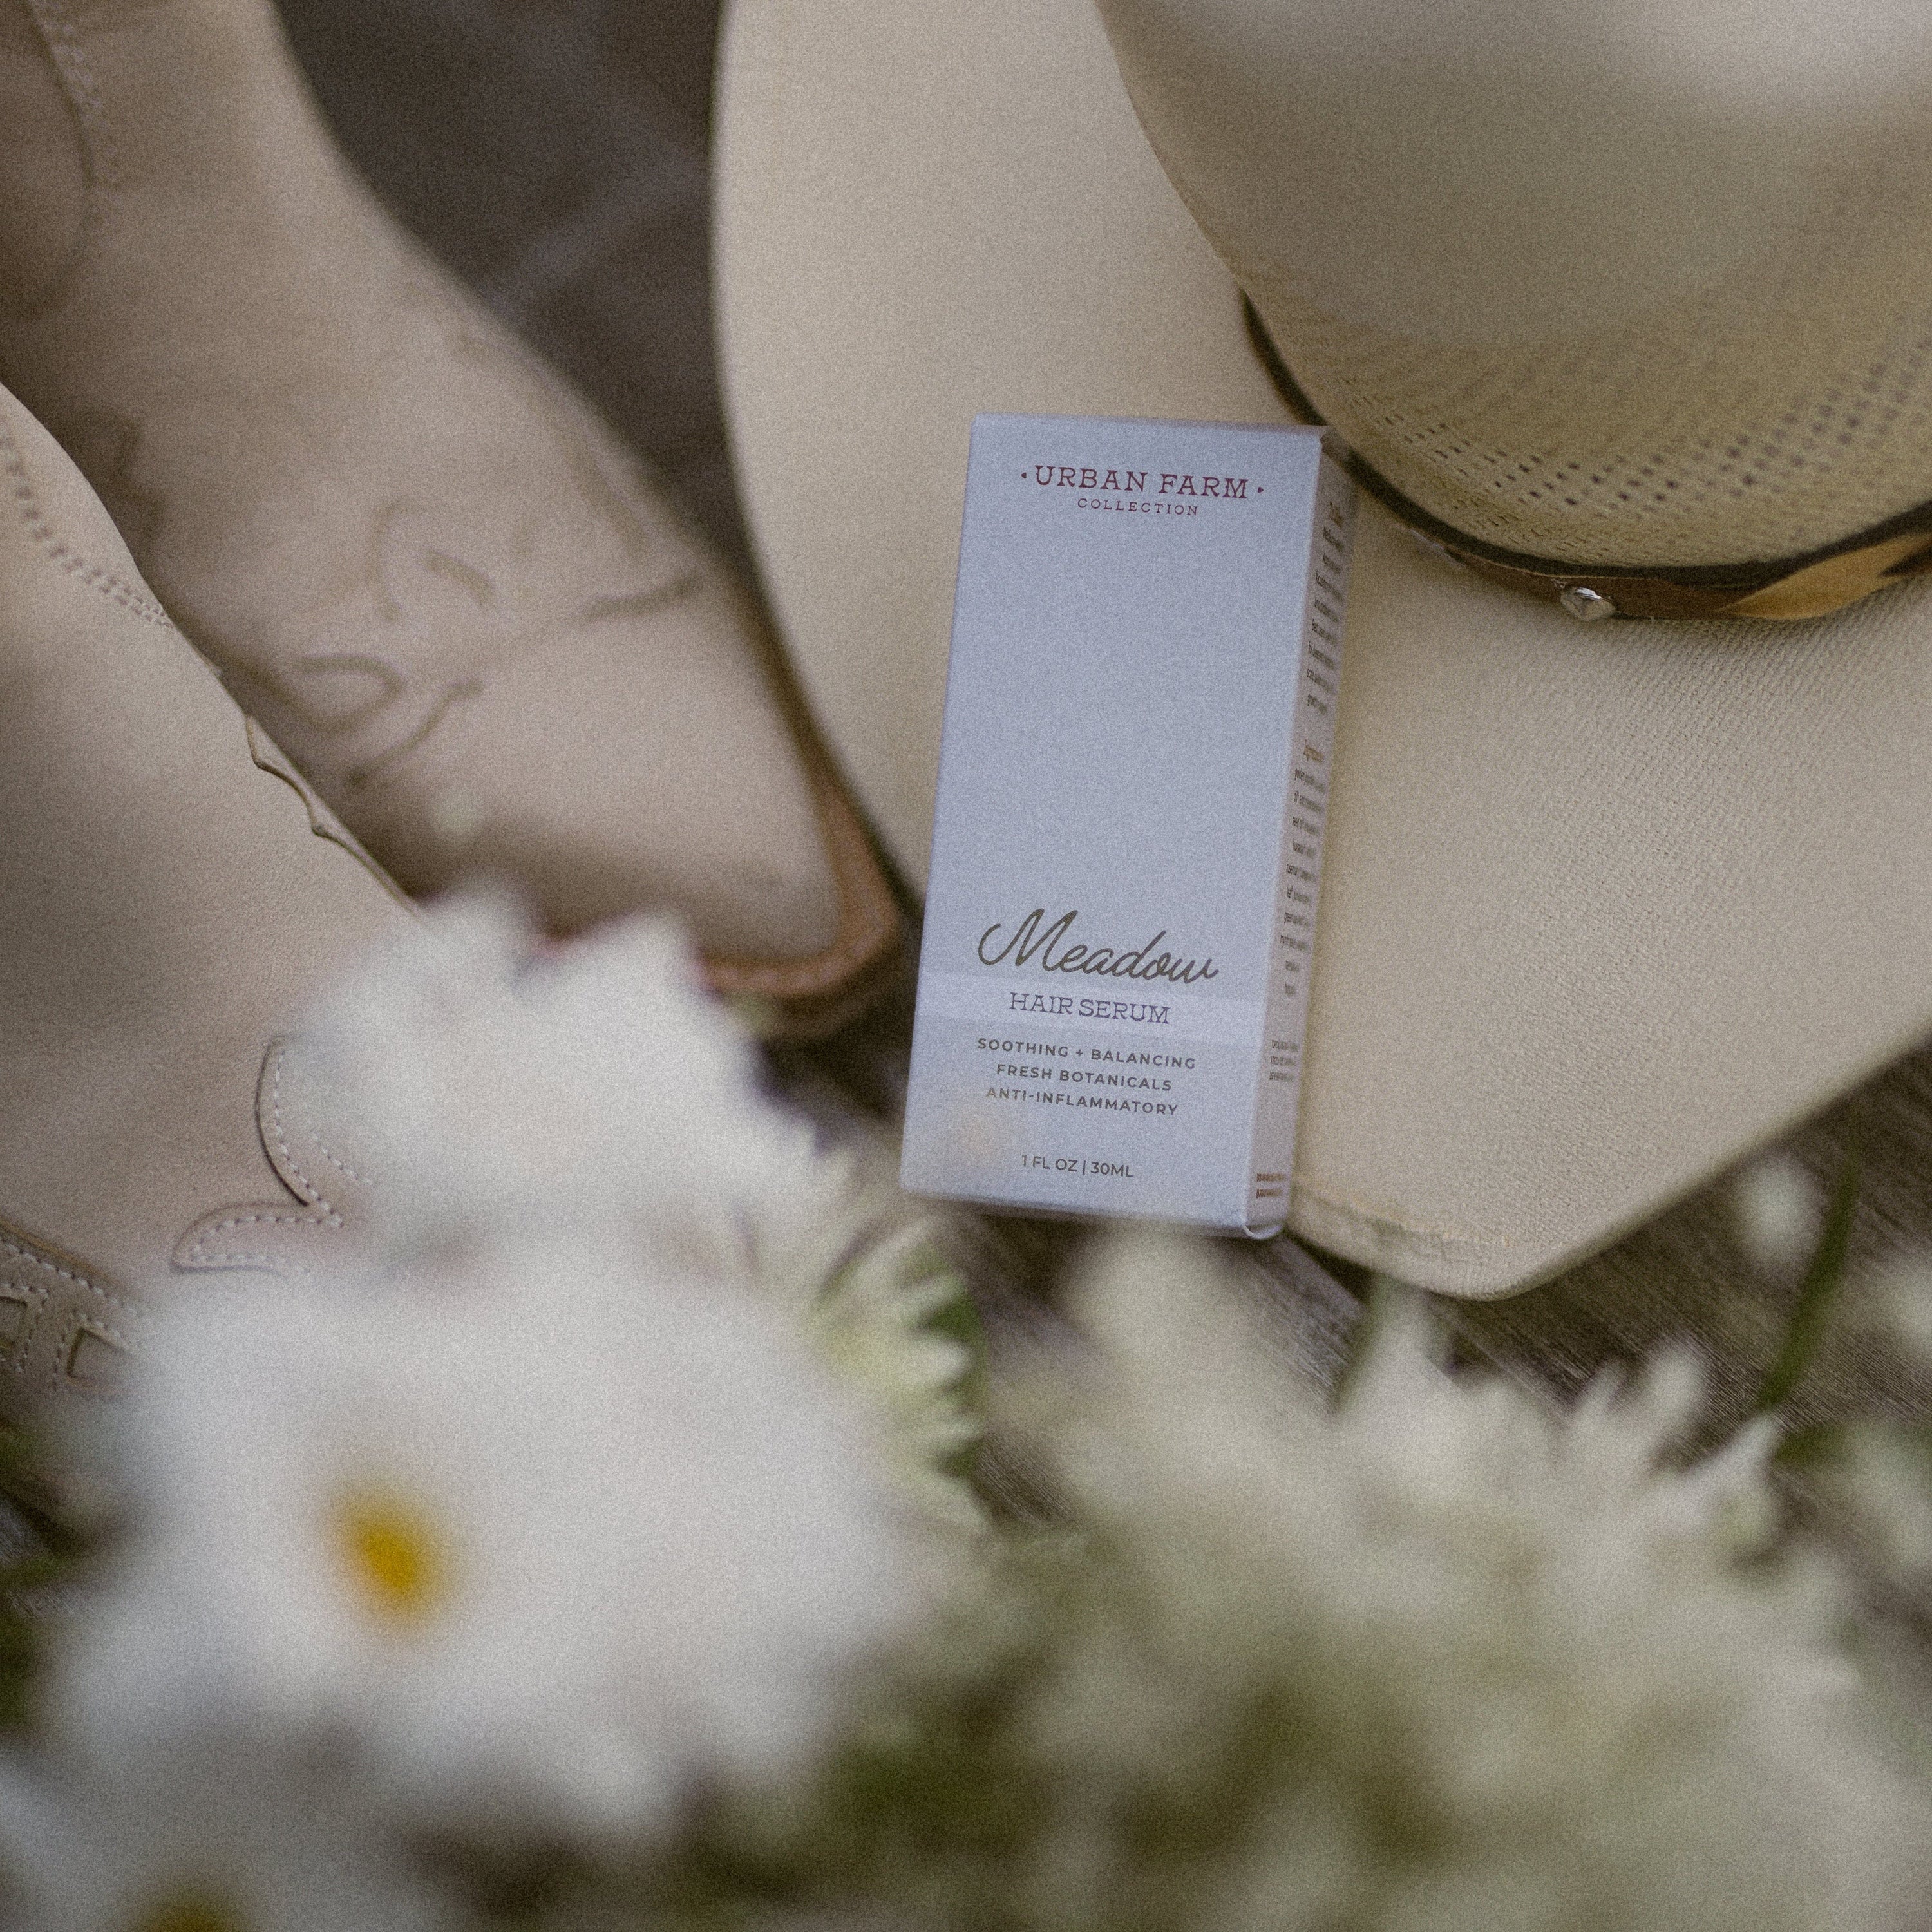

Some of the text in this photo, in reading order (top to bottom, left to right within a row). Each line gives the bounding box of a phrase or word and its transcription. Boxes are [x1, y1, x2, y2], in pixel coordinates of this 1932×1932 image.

[1035, 465, 1249, 499] URBAN FARM
[1077, 498, 1198, 515] COLLECTION
[978, 908, 1219, 983] Meadow
[1010, 992, 1170, 1024] HAIR SERUM
[977, 1038, 1068, 1057] SOOTHING
[1092, 1049, 1195, 1070] BALANCING
[996, 1064, 1171, 1091] FRESH BOTANICALS
[987, 1086, 1179, 1115] ANTI-INFLAMMATORY
[1021, 1155, 1027, 1167] 1
[1032, 1156, 1050, 1170] FL
